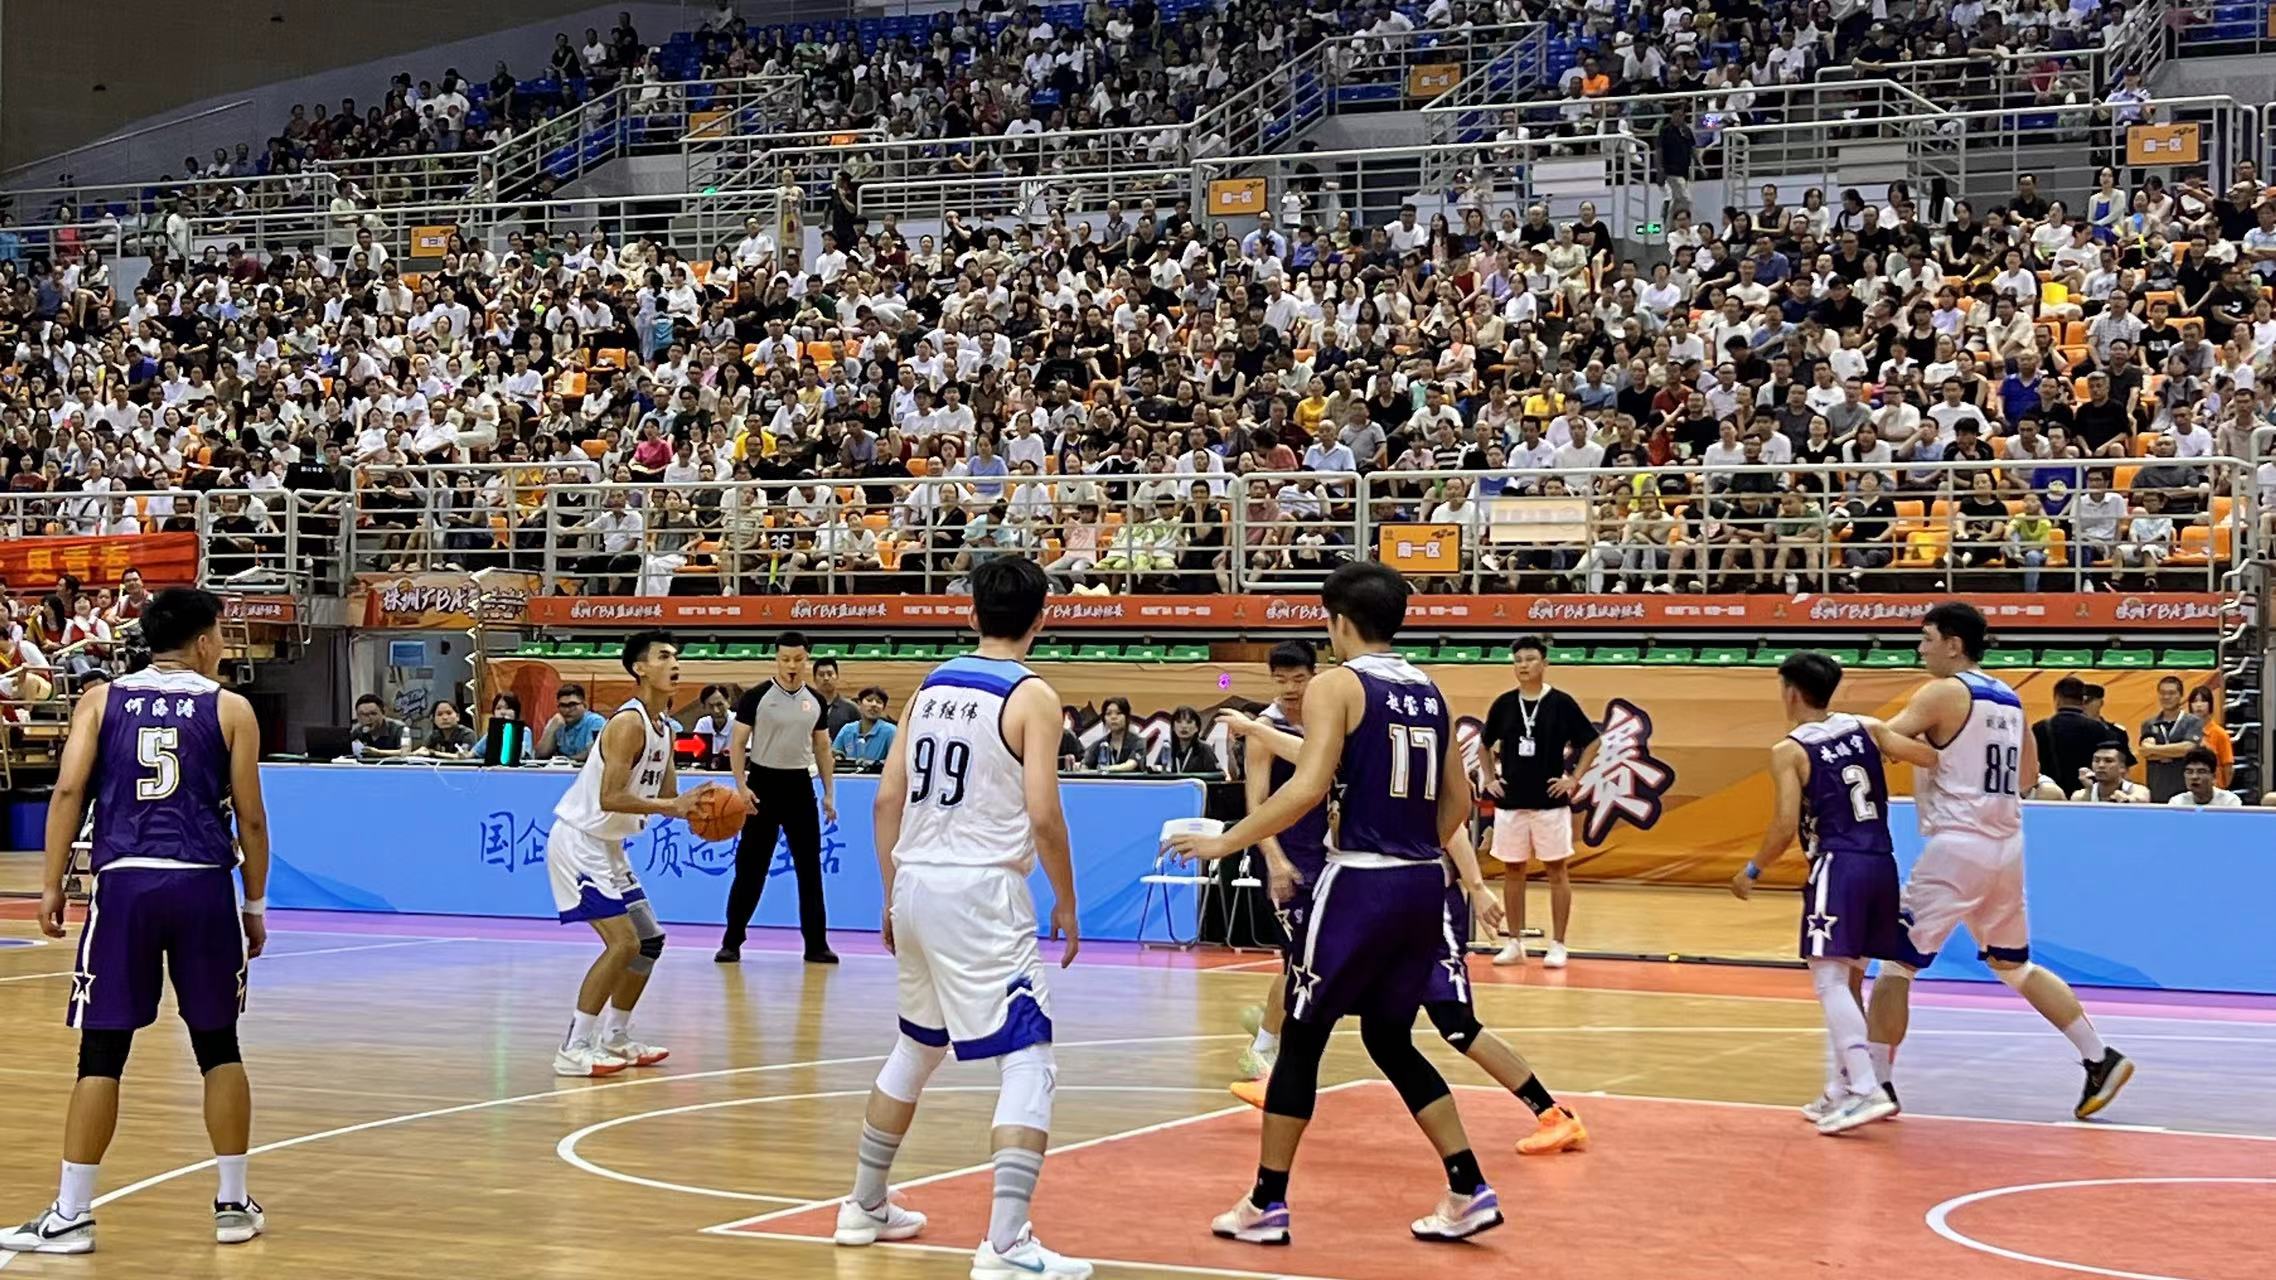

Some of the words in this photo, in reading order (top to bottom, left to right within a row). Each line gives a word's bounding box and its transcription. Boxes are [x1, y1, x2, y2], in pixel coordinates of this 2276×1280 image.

[136, 726, 180, 801] 5
[910, 736, 971, 807] 99
[1388, 723, 1438, 801] 17
[1841, 764, 1879, 823] 2
